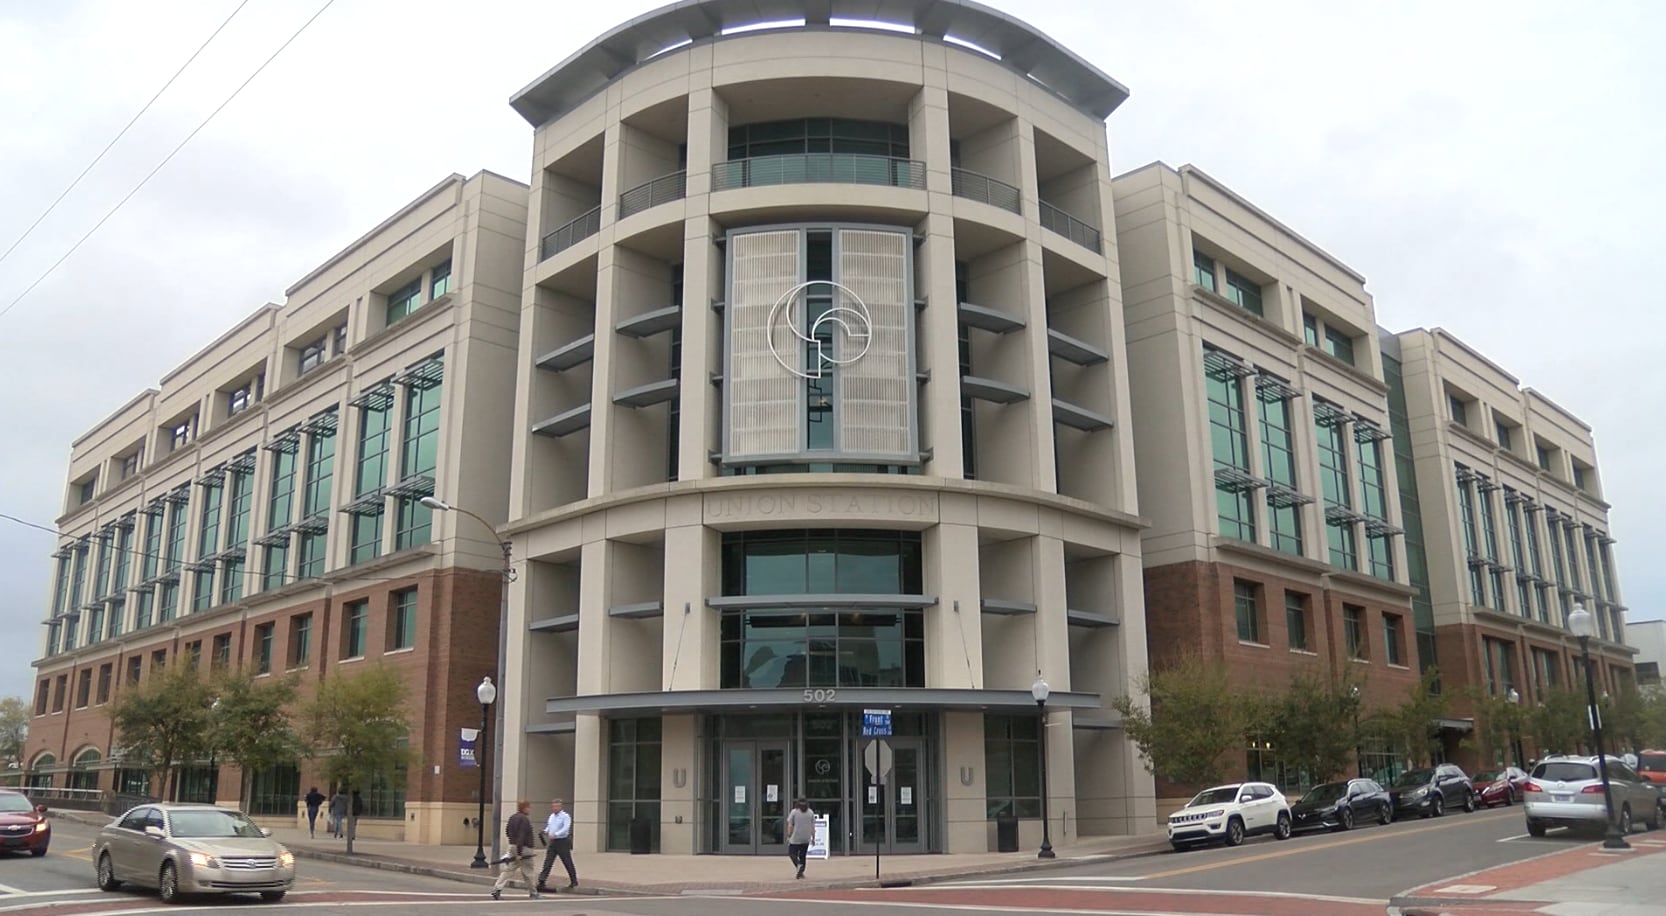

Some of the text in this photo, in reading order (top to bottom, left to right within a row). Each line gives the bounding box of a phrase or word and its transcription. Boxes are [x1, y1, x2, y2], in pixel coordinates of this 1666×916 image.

[706, 493, 935, 517] UNION STATION
[803, 689, 836, 702] 502
